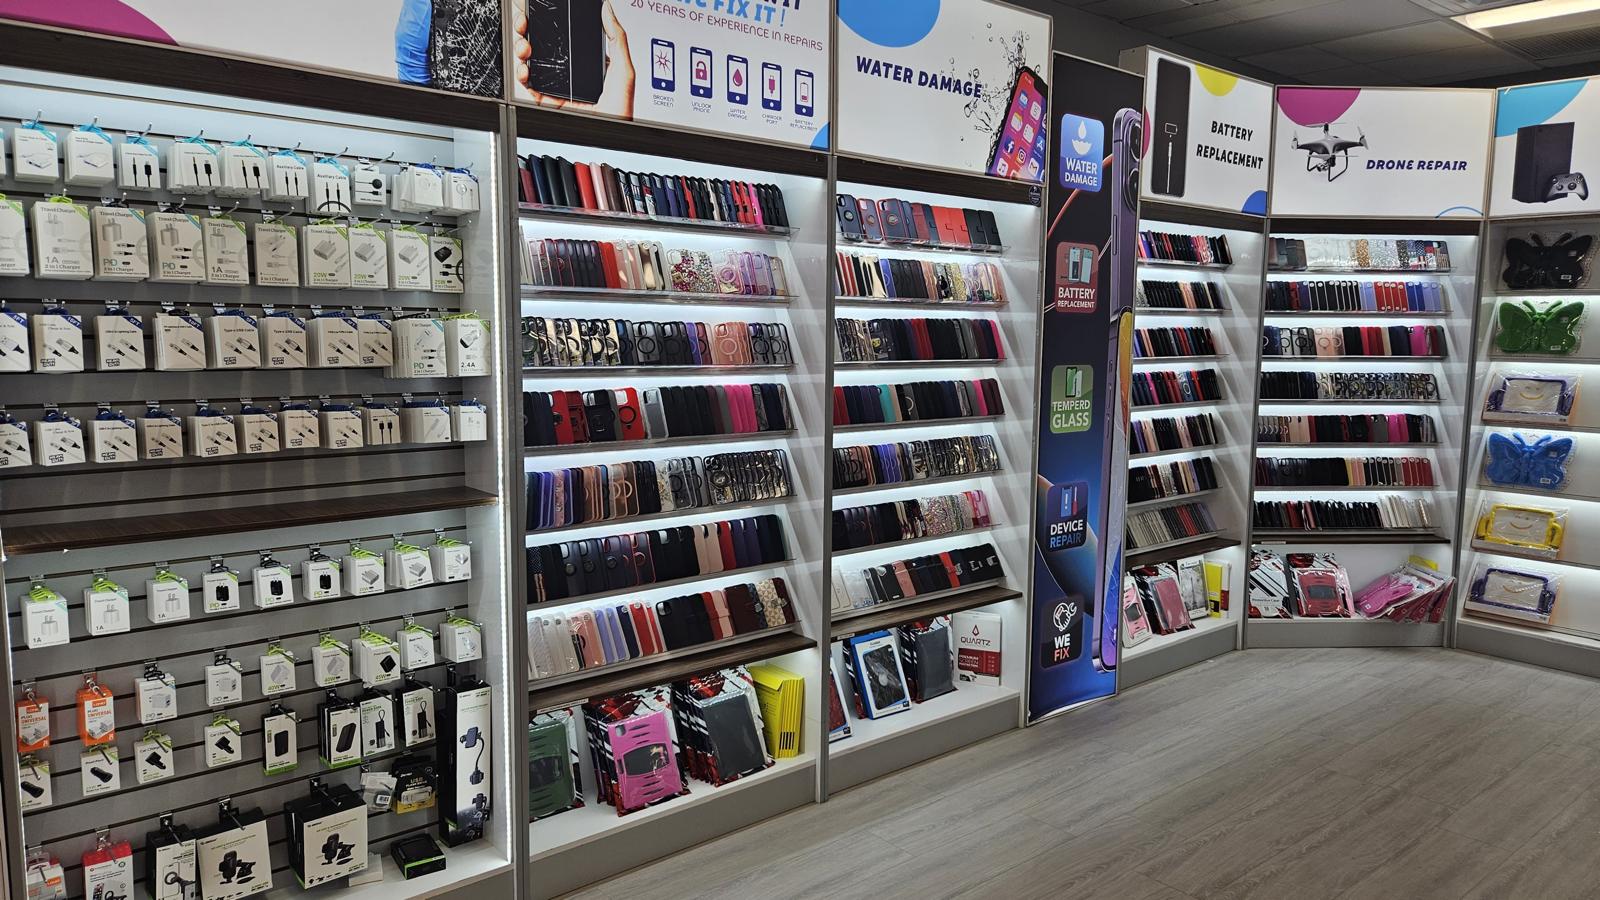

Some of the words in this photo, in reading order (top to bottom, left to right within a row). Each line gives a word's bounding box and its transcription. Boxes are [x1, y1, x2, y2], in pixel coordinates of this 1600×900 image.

[630, 0, 644, 8] 20
[649, 2, 686, 19] YEARS
[689, 10, 704, 22] OF
[707, 15, 769, 39] EXPERIENCE
[771, 31, 781, 41] IN
[784, 33, 823, 51] REPAIRS
[856, 55, 914, 84] WATER
[917, 70, 983, 99] DAMAGE
[653, 100, 674, 108] SCREEN
[691, 101, 712, 109] UNLOCK
[1211, 121, 1253, 141] BATTERY
[1196, 144, 1264, 169] REPLACEMENT
[1066, 157, 1098, 175] WATER
[1366, 160, 1414, 170] DRONE
[1417, 160, 1468, 170] REPAIR
[1064, 172, 1098, 186] DAMAGE
[162, 262, 176, 270] PD
[1058, 287, 1096, 300] BATTERY
[1057, 300, 1095, 308] REPLACEMENT
[13, 314, 25, 324] 5FT
[129, 317, 141, 326] 5FT
[1052, 400, 1090, 412] TEMPERD
[1052, 412, 1089, 428] GLASS
[1050, 519, 1083, 535] DEVICE
[1050, 532, 1082, 549] REPAIR
[960, 636, 991, 647] QUARTZ
[1054, 633, 1071, 649] WE
[1054, 647, 1070, 662] FIX
[87, 710, 112, 718] UNIVERSAL
